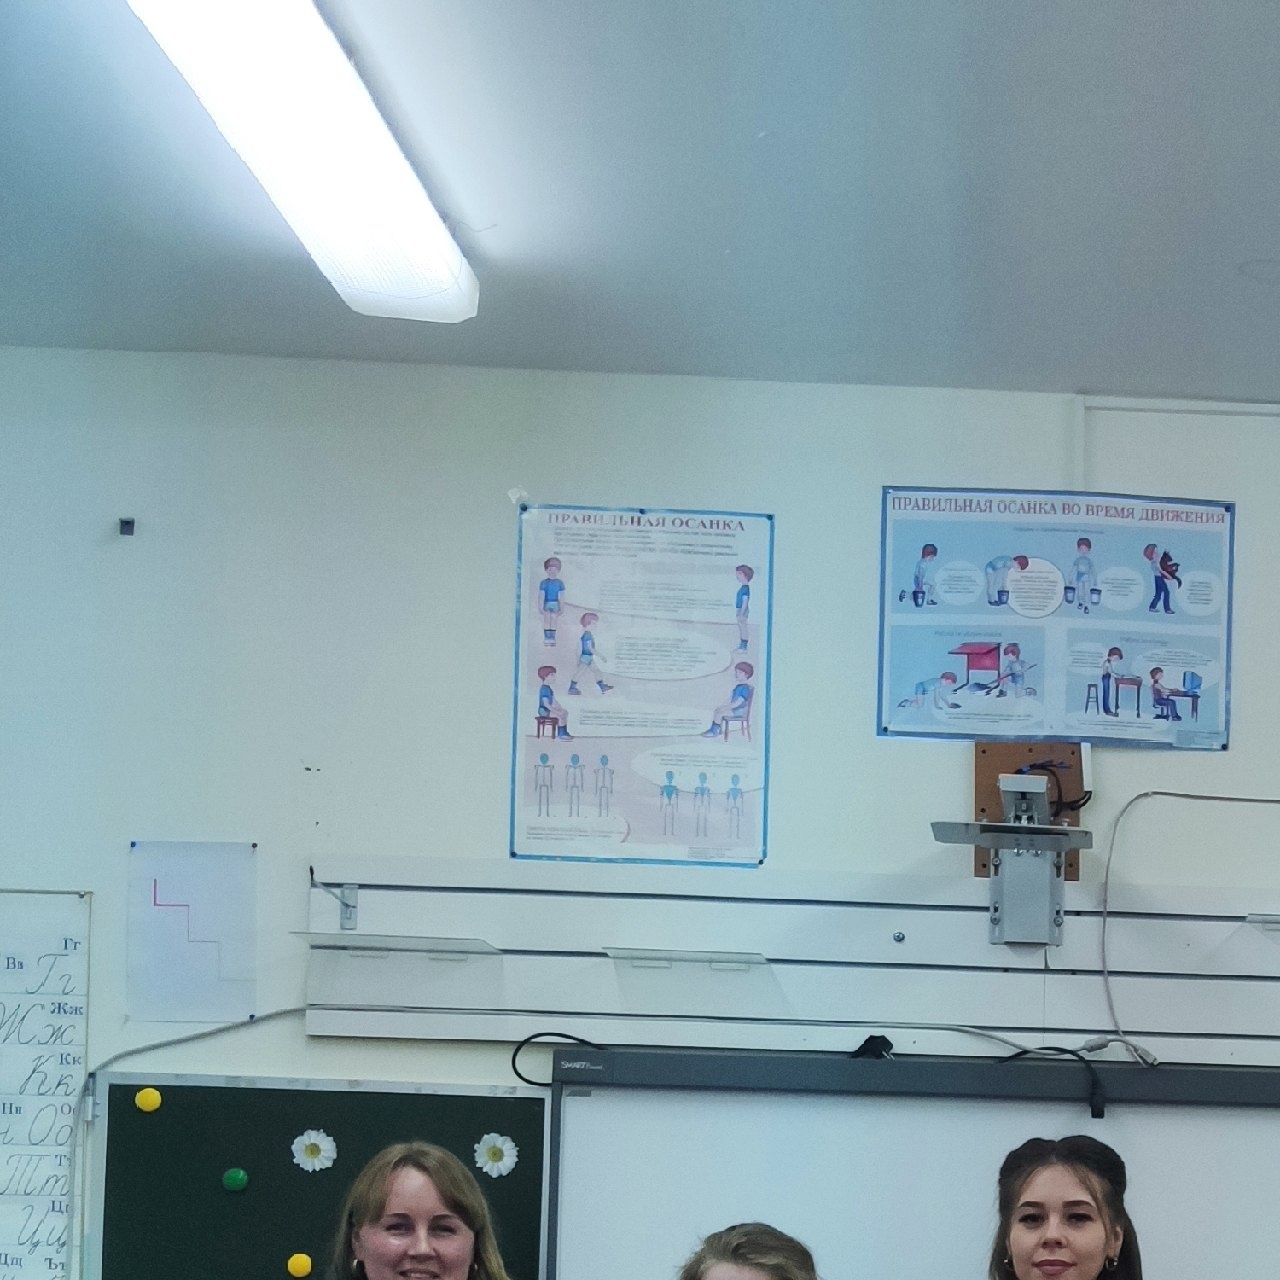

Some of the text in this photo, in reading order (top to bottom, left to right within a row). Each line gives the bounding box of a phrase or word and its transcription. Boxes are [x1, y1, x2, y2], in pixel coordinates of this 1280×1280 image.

[892, 496, 1225, 524] ПРАВИЛЬНАЯ ОСАНКА ВО ВРЕМЯ ДВИЖЕНИЯ
[671, 517, 745, 532] ОСАНКА
[50, 1002, 84, 1015] Жж
